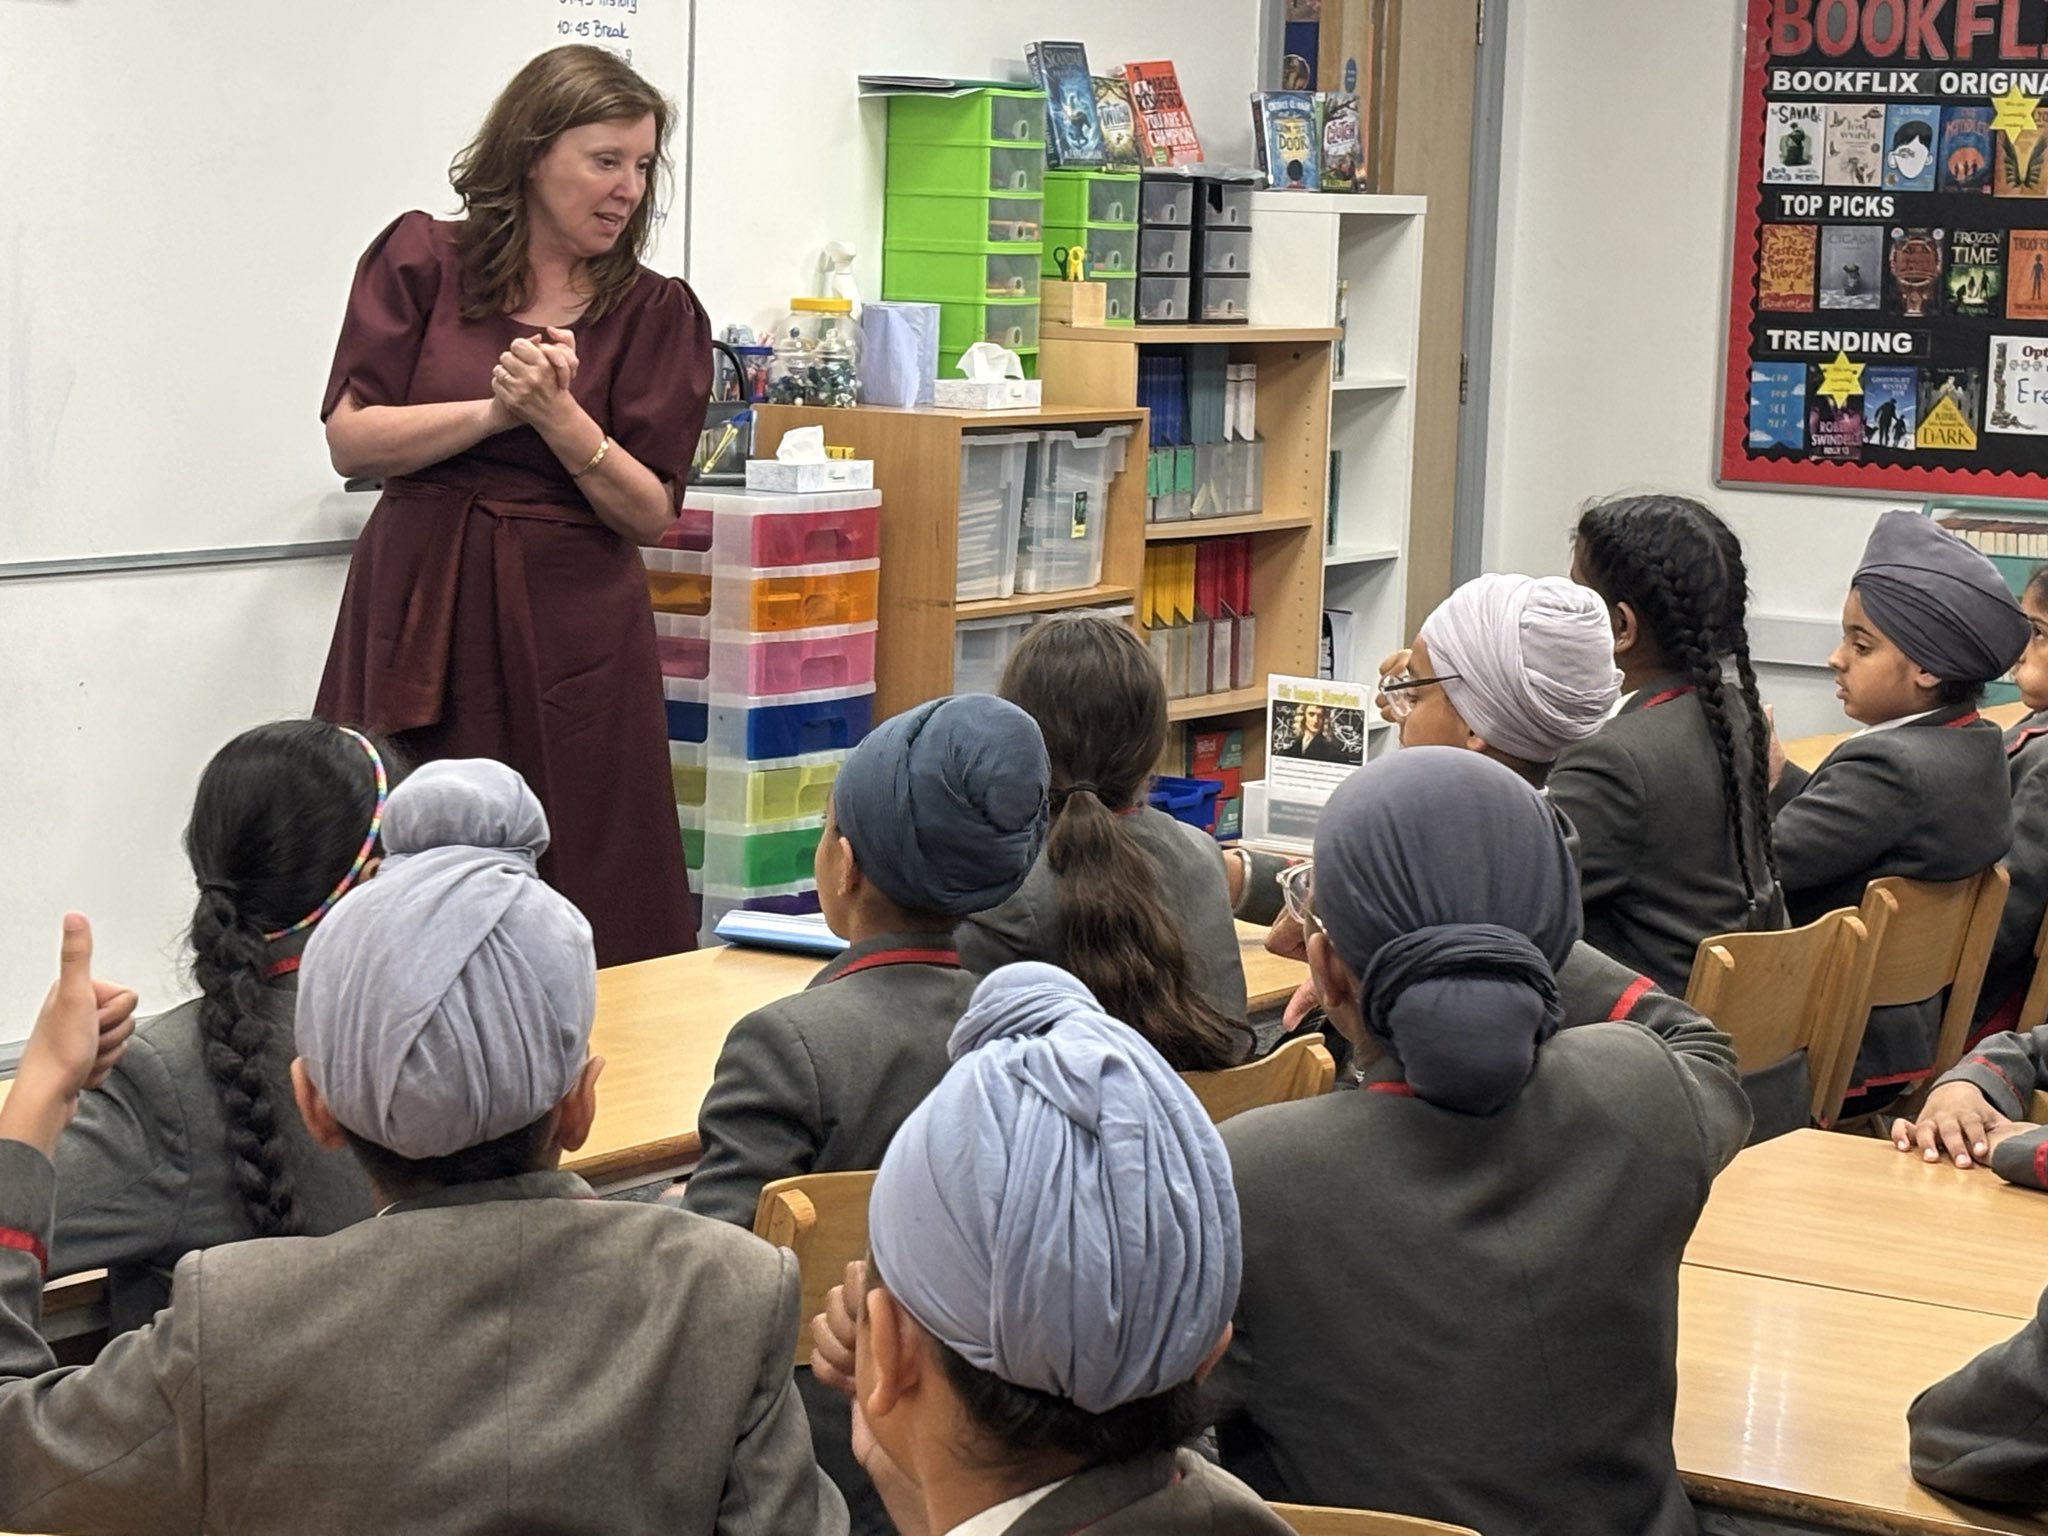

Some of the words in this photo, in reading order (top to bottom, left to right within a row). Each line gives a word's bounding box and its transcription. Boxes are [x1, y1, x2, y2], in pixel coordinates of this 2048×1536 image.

[557, 20, 590, 37] 10:45
[593, 20, 630, 39] Break
[1772, 70, 1920, 93] BOOKFLIX
[1279, 134, 1309, 151] DOOR
[1781, 194, 1823, 216] TOP
[1828, 195, 1895, 218] PICKS
[1953, 231, 2000, 244] FROZEN
[1952, 246, 2000, 264] TIME
[1767, 329, 1913, 353] TRENDING
[1923, 428, 1971, 445] DARK
